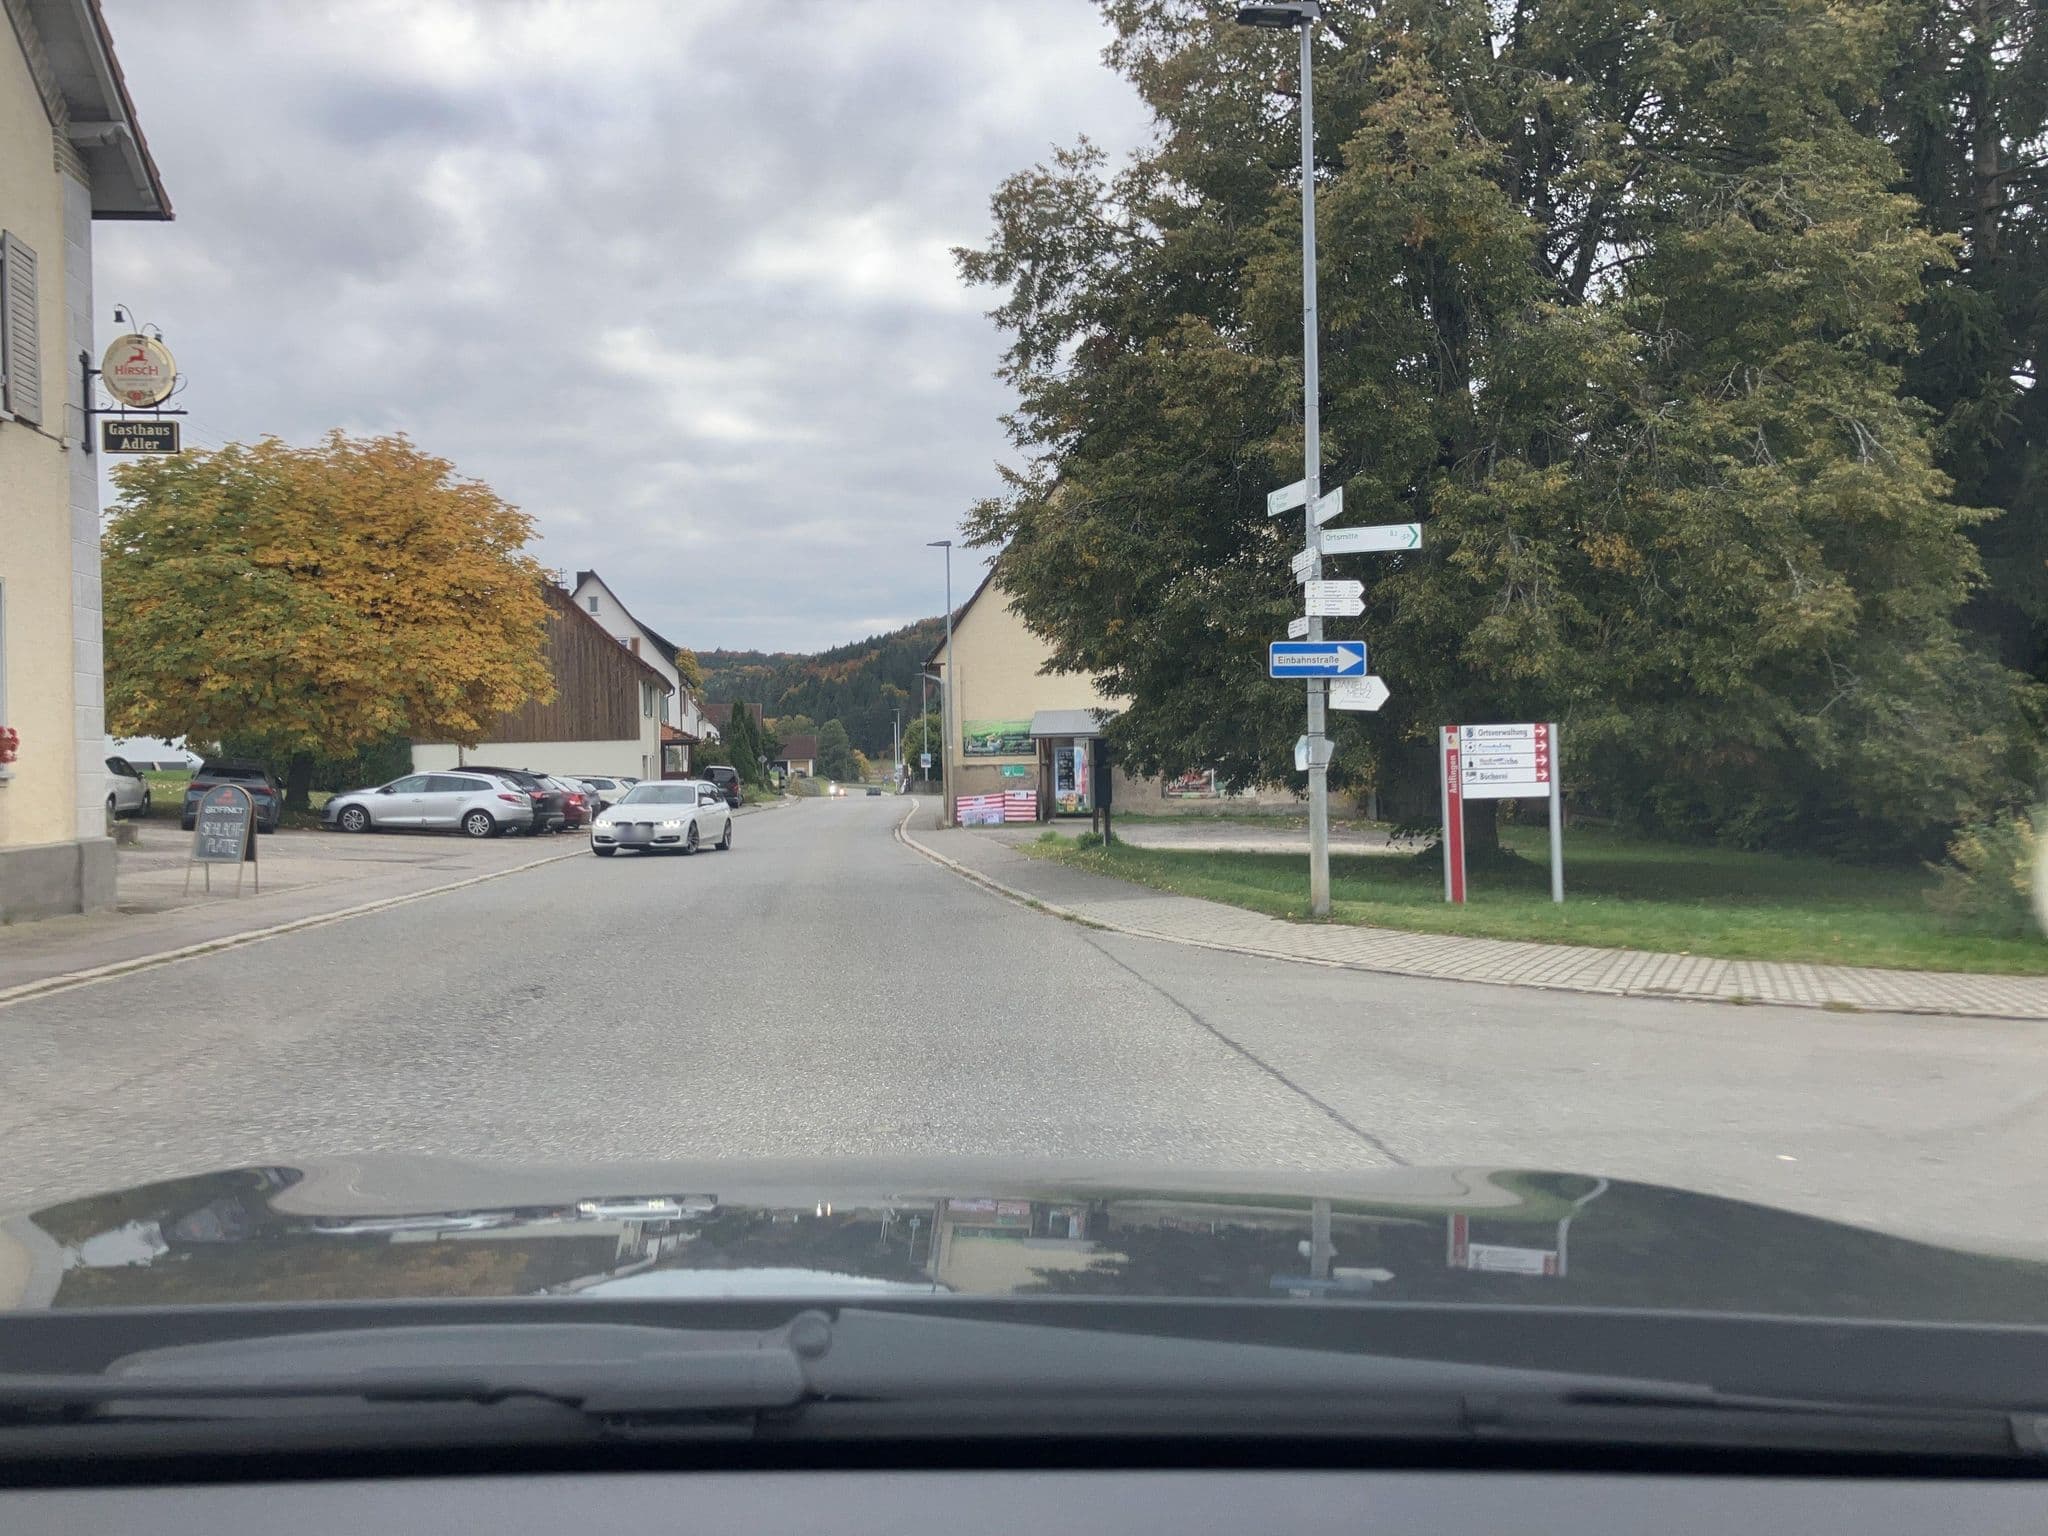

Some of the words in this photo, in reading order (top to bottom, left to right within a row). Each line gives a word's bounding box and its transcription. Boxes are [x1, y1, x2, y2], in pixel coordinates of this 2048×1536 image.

[109, 423, 171, 436] Gasthaus
[121, 437, 160, 450] Adler
[1326, 532, 1358, 541] Ortsmitte
[1277, 655, 1340, 665] Einbahnstraße
[1478, 728, 1528, 738] Ortsverwaltung
